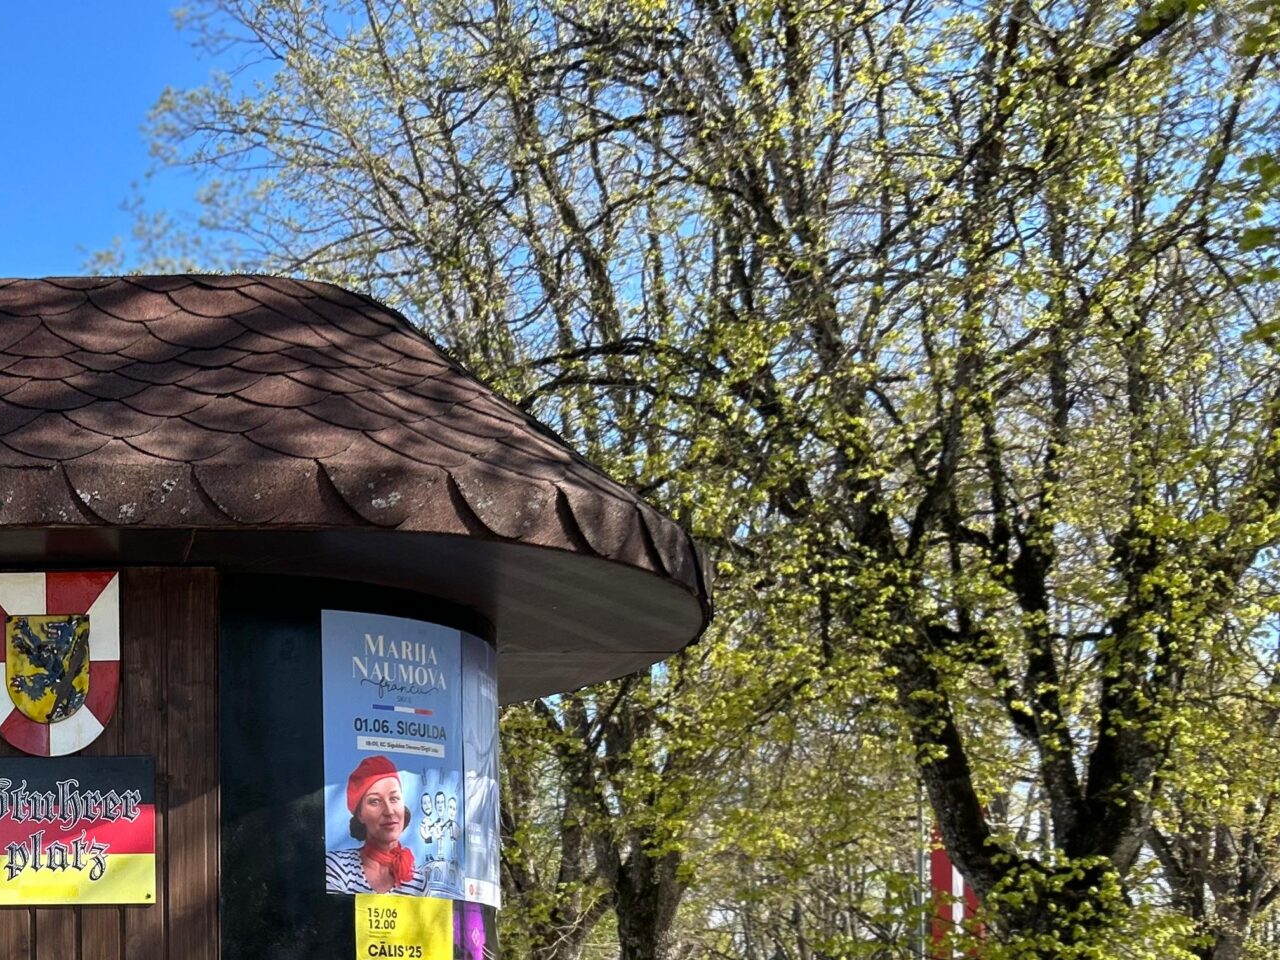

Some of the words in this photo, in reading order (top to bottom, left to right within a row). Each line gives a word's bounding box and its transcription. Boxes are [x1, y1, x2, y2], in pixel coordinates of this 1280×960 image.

[365, 634, 437, 665] MARIJA
[352, 656, 447, 690] NAUMOVA
[354, 717, 393, 735] 01.06.
[397, 720, 447, 741] SIGULDA
[4, 830, 110, 881] platz
[368, 908, 398, 919] 15/06
[368, 919, 396, 930] 12.00
